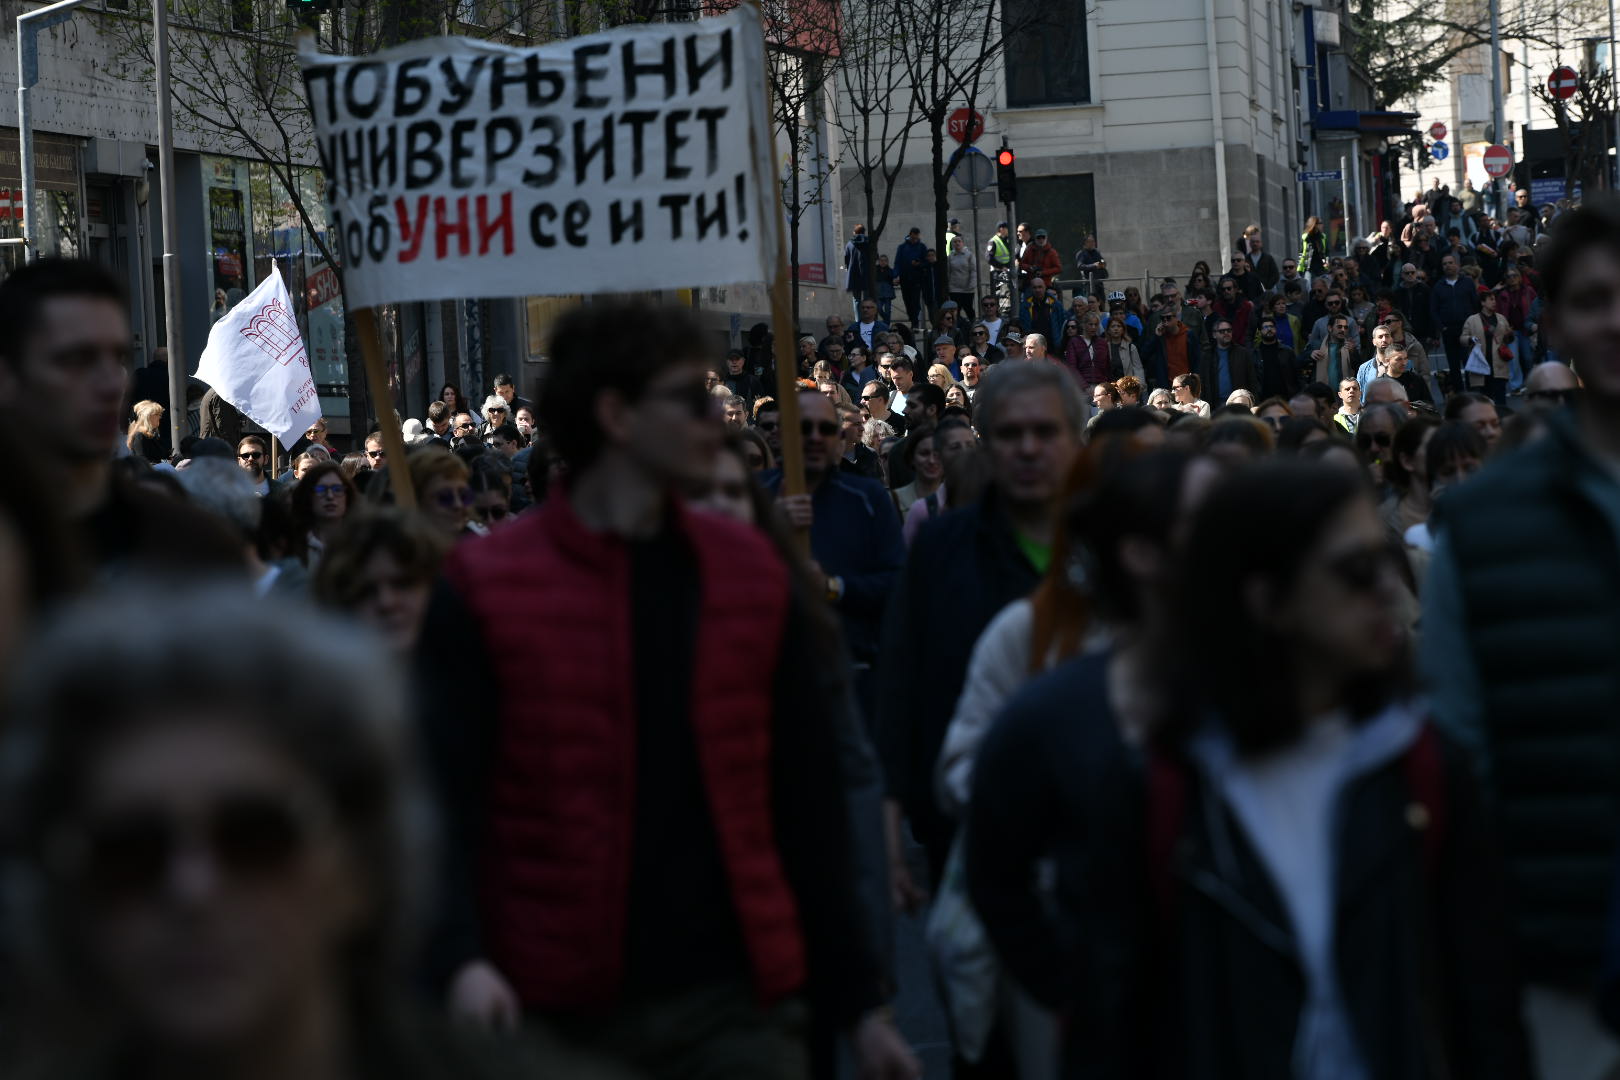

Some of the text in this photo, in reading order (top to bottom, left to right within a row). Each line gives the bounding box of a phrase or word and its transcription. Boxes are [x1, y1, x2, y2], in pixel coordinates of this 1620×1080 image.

[303, 28, 733, 125] ПОБУЊЕНИ
[317, 106, 728, 204] УНИВЕРЗИТЕТ
[951, 119, 981, 132] STP
[529, 199, 591, 248] се
[610, 200, 643, 245] и
[659, 173, 749, 243] ти!
